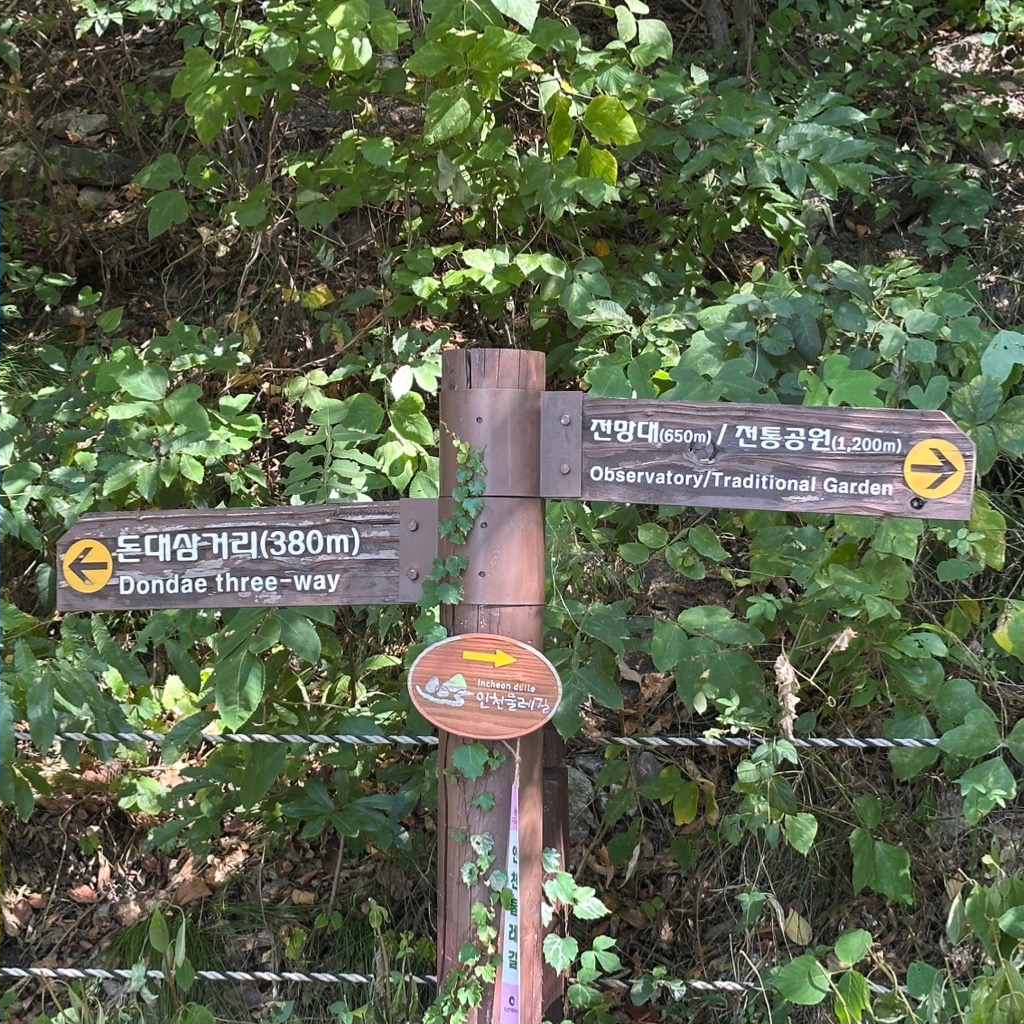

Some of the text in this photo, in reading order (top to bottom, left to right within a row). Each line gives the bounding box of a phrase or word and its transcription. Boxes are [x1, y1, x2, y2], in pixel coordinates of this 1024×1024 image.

[589, 418, 903, 454] 전망대(650m) / 전통공원(1,200m)
[589, 465, 894, 496] Observatory/Traditional Garden
[115, 527, 361, 563] 돈대삼거리(380m)
[118, 572, 341, 596] Dondae three-way
[477, 678, 511, 690] Incheon
